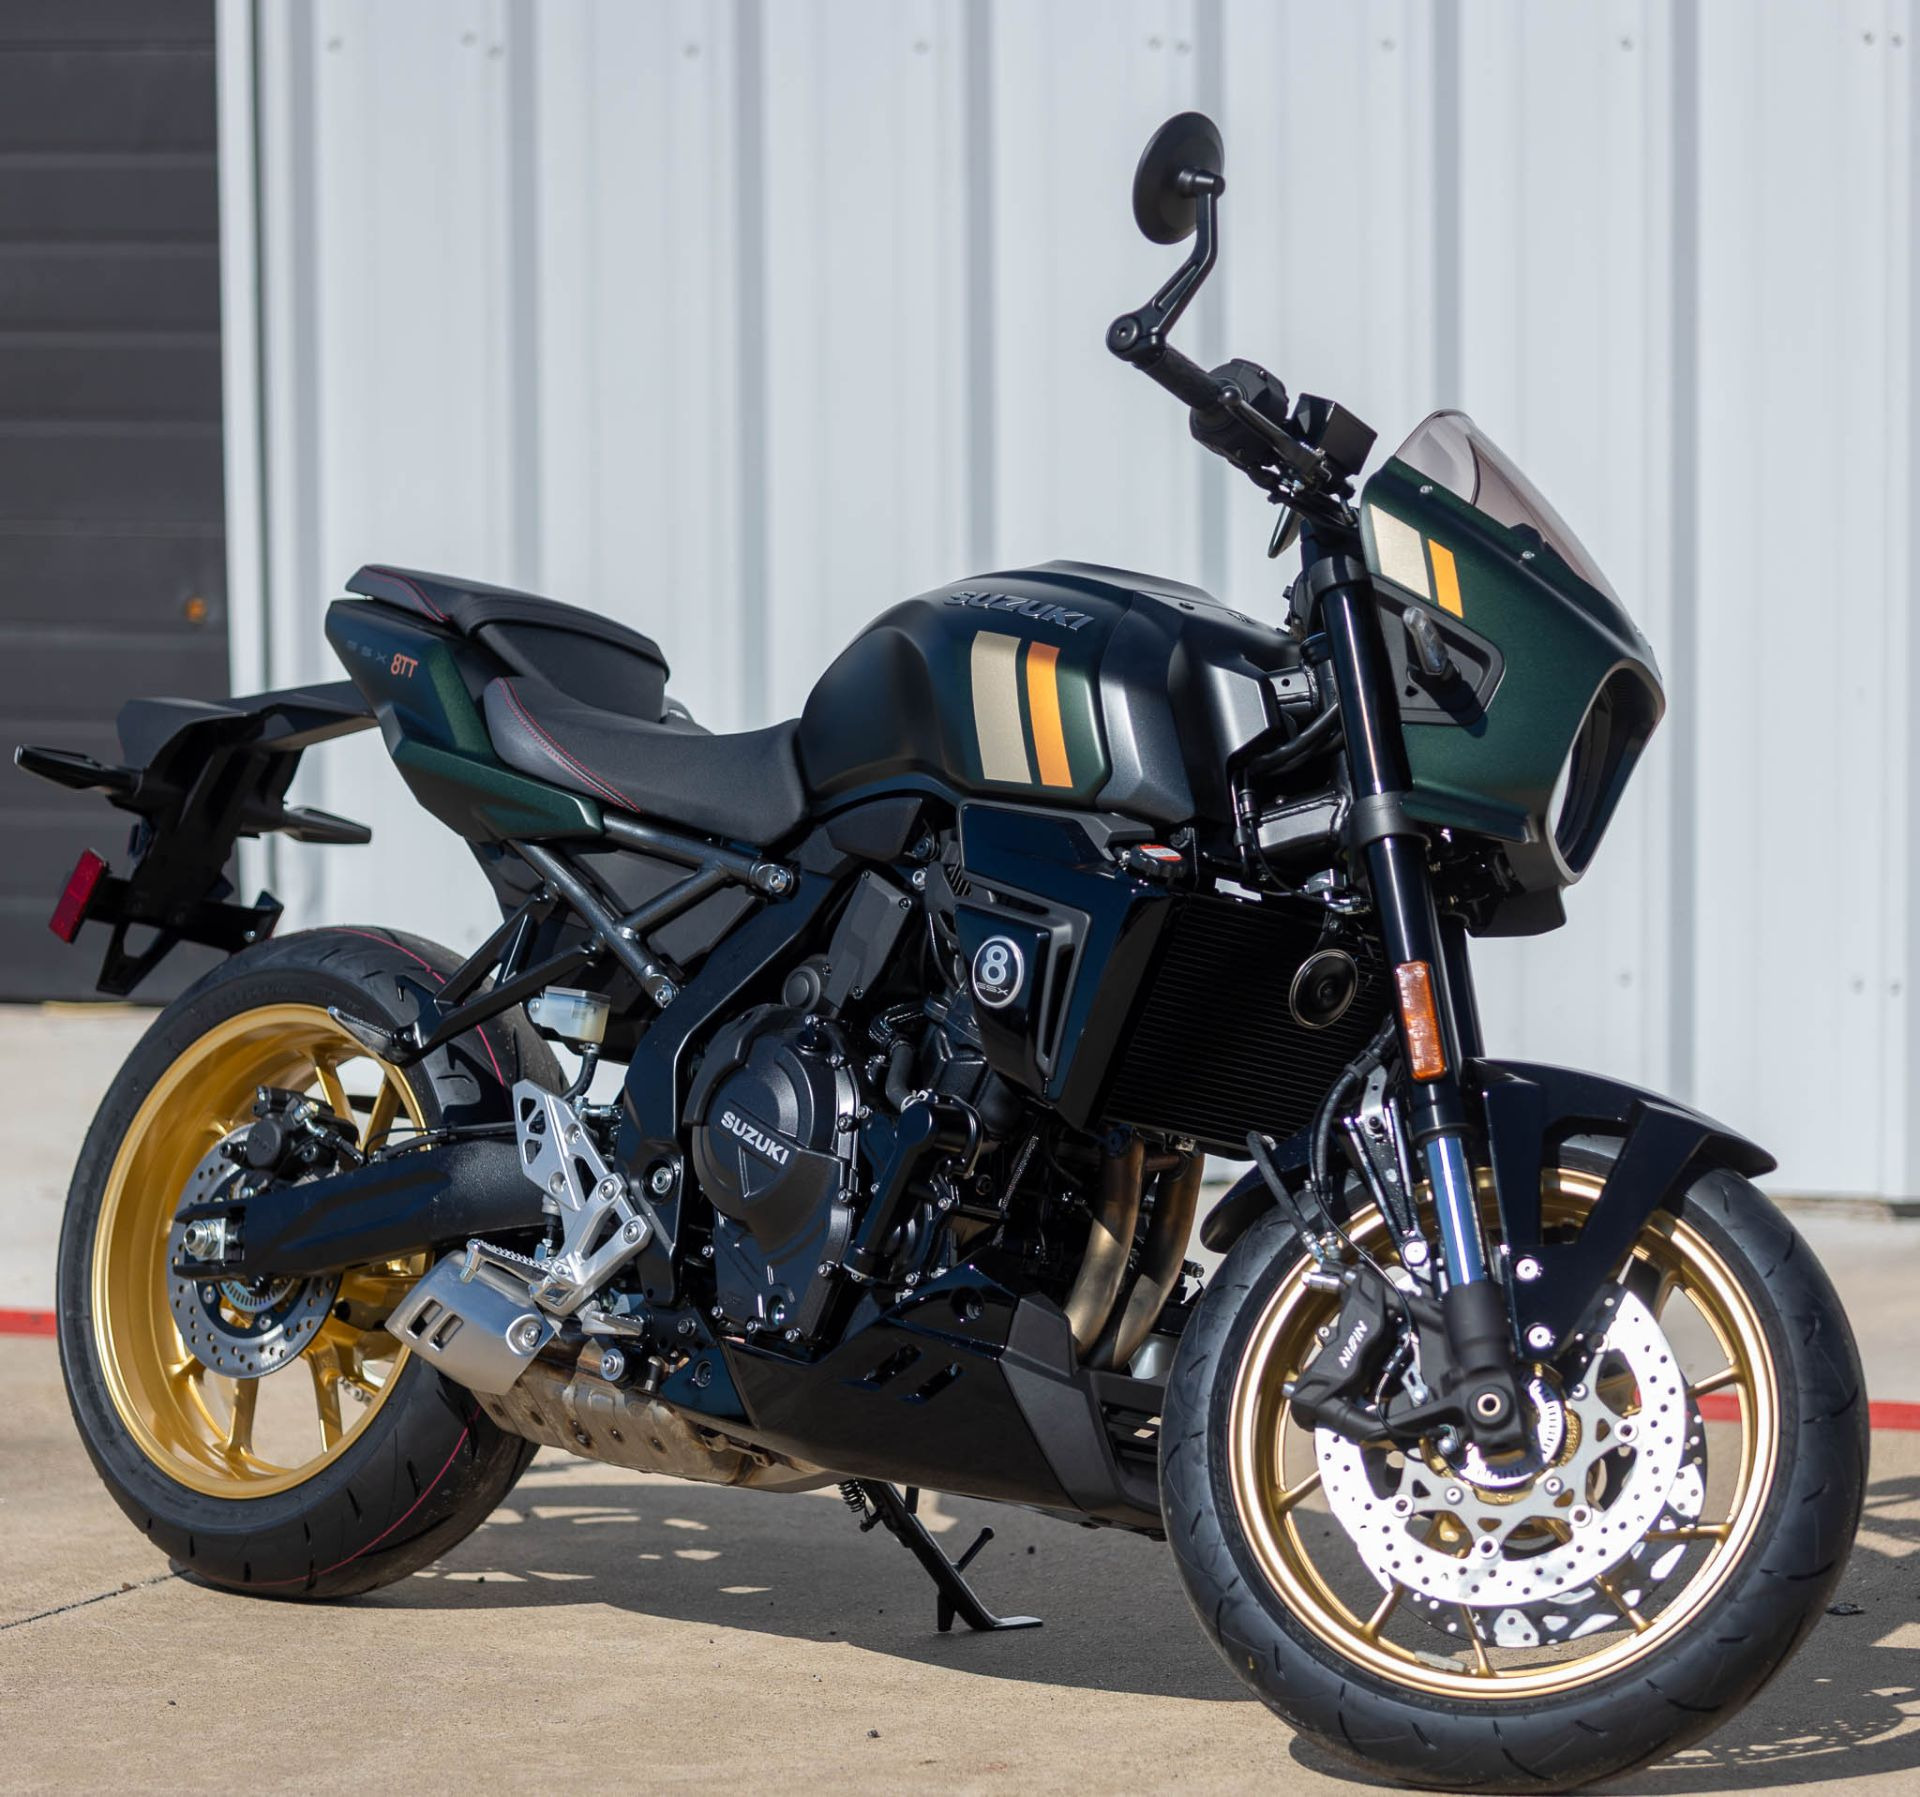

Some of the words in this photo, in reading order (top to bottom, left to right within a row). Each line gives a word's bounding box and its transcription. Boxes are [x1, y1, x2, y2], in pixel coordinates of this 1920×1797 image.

[944, 591, 1095, 631] SUZUKI
[390, 652, 419, 678] 8TT
[981, 944, 1009, 985] 8
[720, 1111, 790, 1165] SUZUKI
